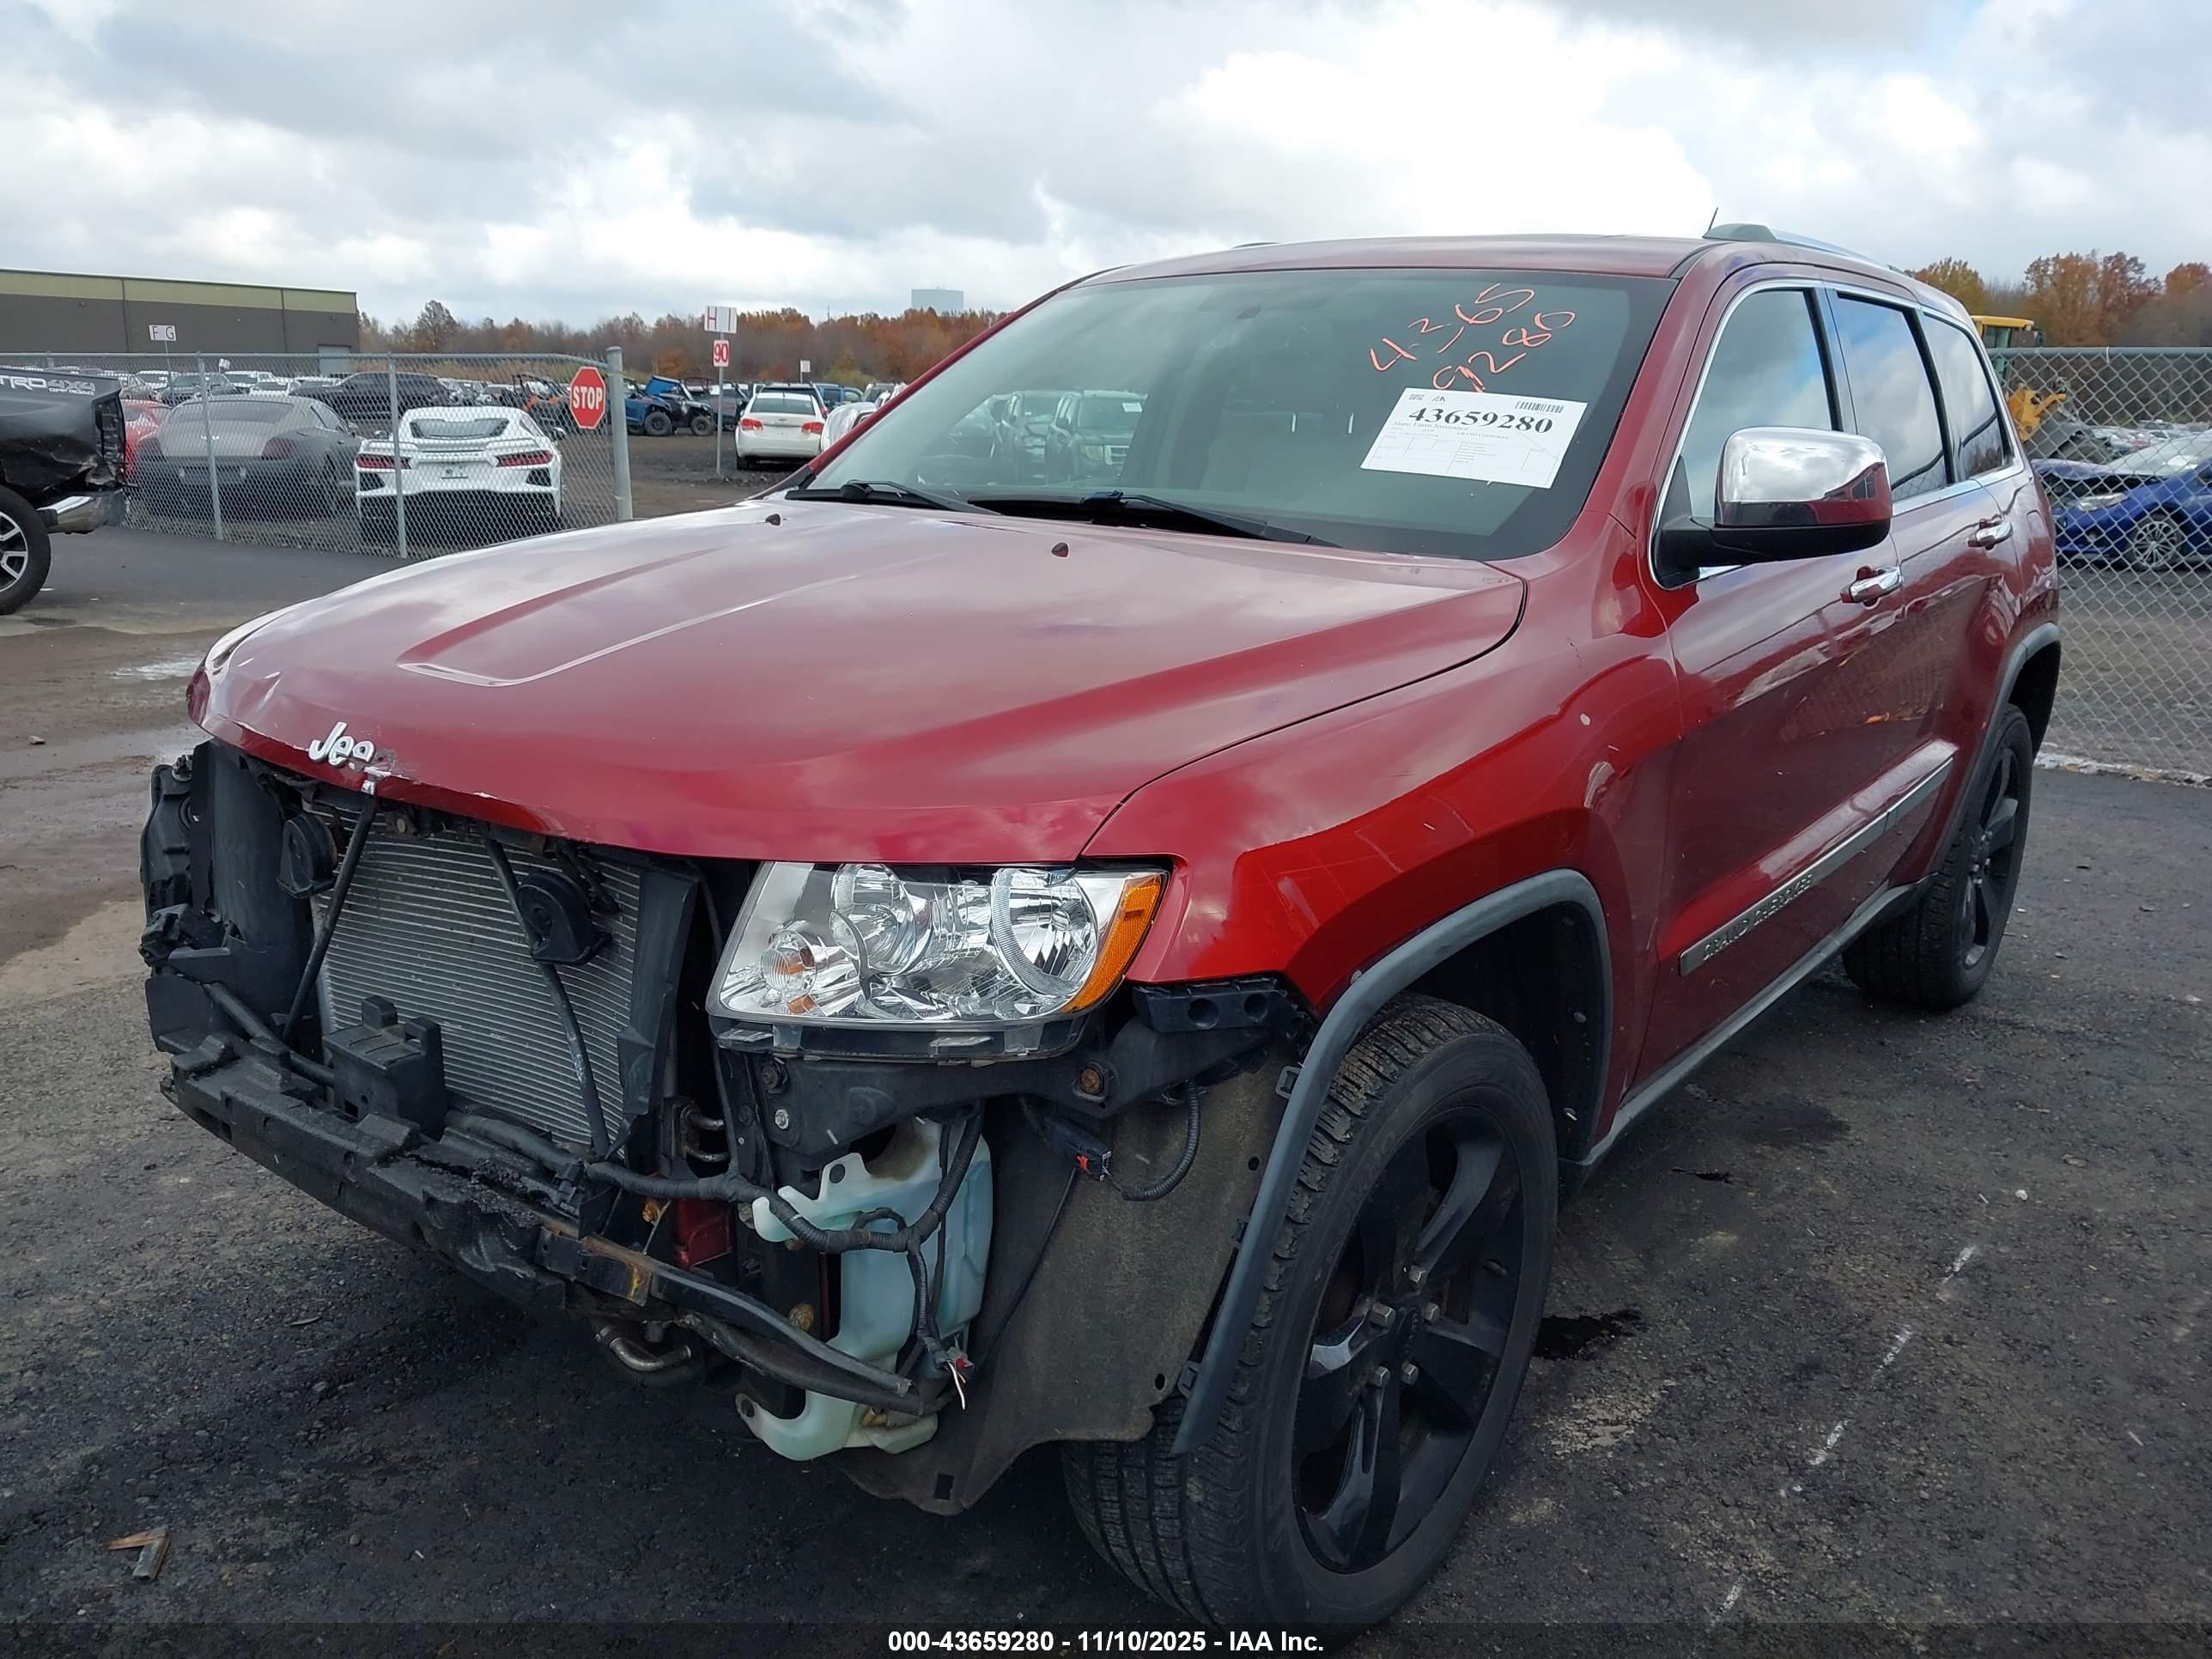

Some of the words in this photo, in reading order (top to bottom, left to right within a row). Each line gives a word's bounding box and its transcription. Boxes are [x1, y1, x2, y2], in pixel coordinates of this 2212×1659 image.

[707, 306, 718, 331] H
[151, 325, 159, 340] F
[165, 326, 174, 340] G
[714, 343, 729, 362] 90
[0, 375, 47, 390] TRD
[573, 385, 603, 410] STOP
[1408, 407, 1553, 433] 43659280
[308, 721, 392, 777] Jee
